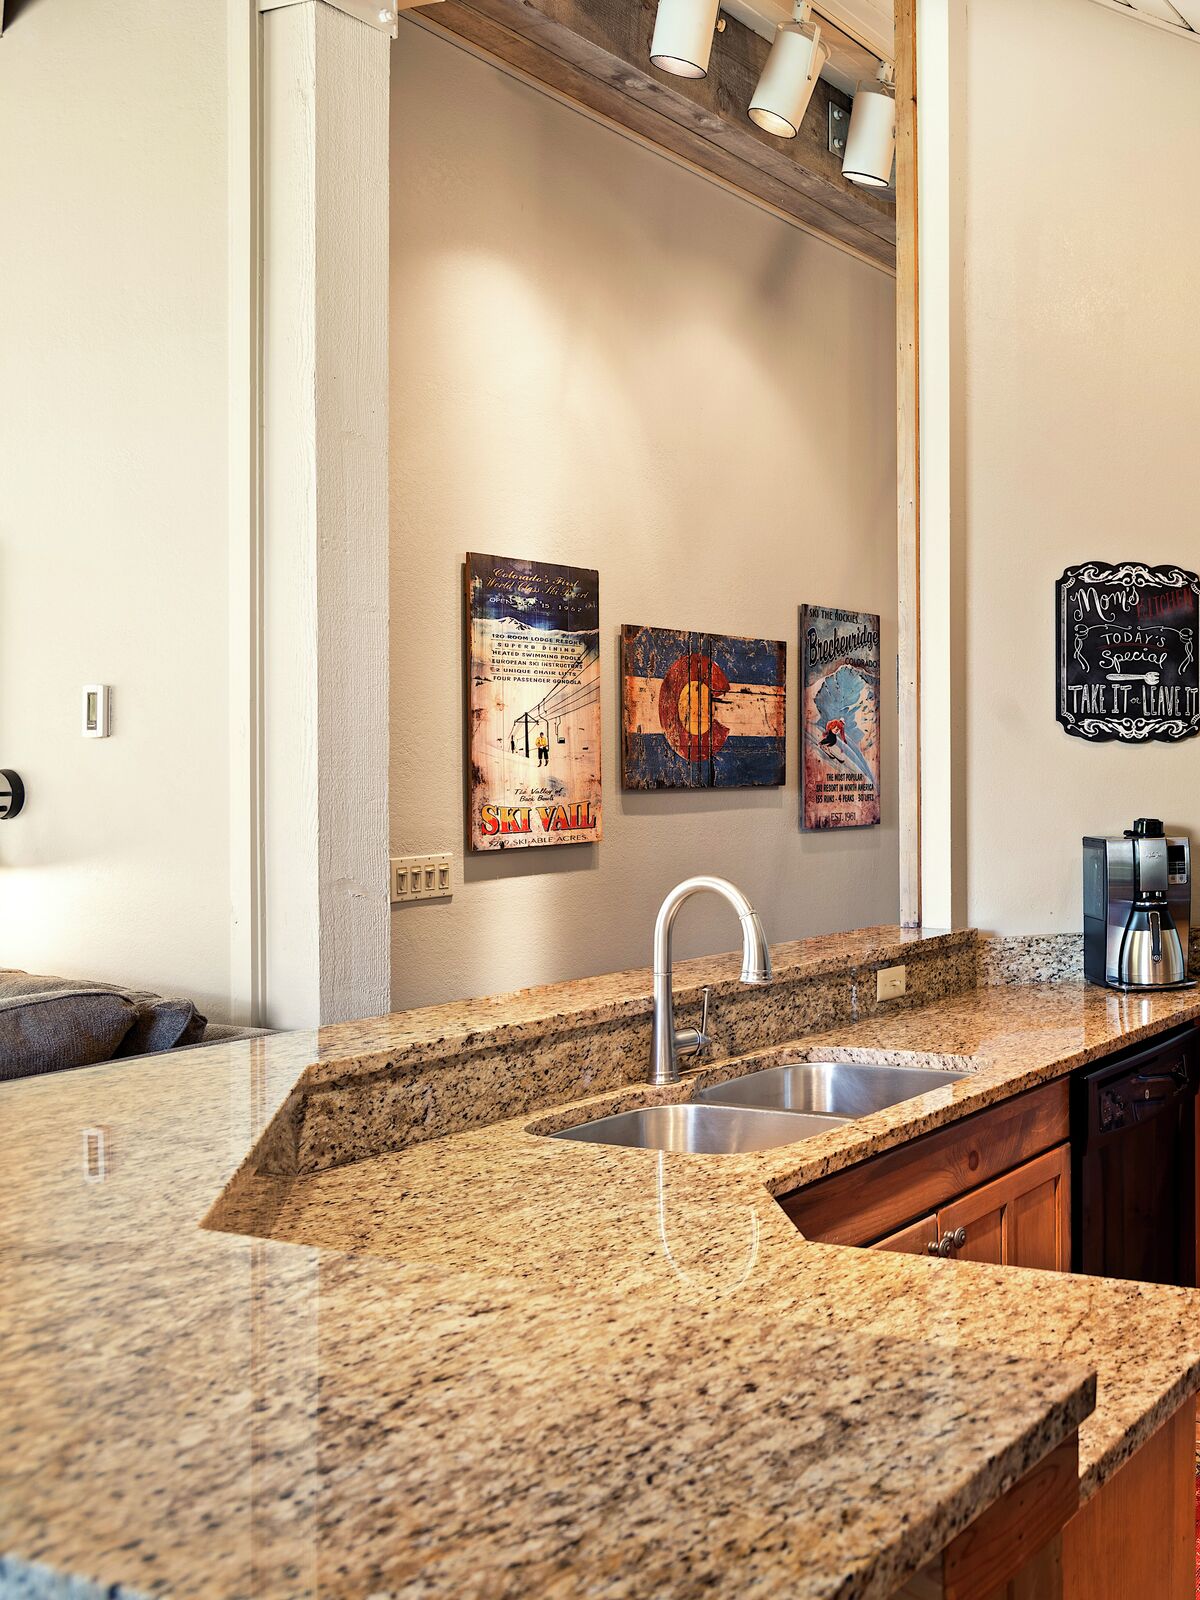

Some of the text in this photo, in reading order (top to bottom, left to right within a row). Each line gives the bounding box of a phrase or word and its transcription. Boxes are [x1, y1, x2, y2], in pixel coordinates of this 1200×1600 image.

[486, 576, 514, 590] World
[517, 581, 540, 593] Class
[542, 585, 559, 595] Ski
[492, 568, 548, 583] Colorado's
[809, 608, 819, 618] SKI
[821, 610, 832, 620] THE
[1070, 586, 1194, 622] Mom's KITCHEN
[808, 625, 879, 667] Breckenridge
[1100, 632, 1166, 647] TODAY'S
[845, 658, 878, 668] COLORADO
[1099, 648, 1168, 673] Special
[1068, 684, 1106, 714] TAKE
[1112, 684, 1132, 714] IT
[1142, 685, 1181, 716] LEAVE
[1184, 686, 1198, 716] IT
[480, 800, 596, 835] SKI VAIL
